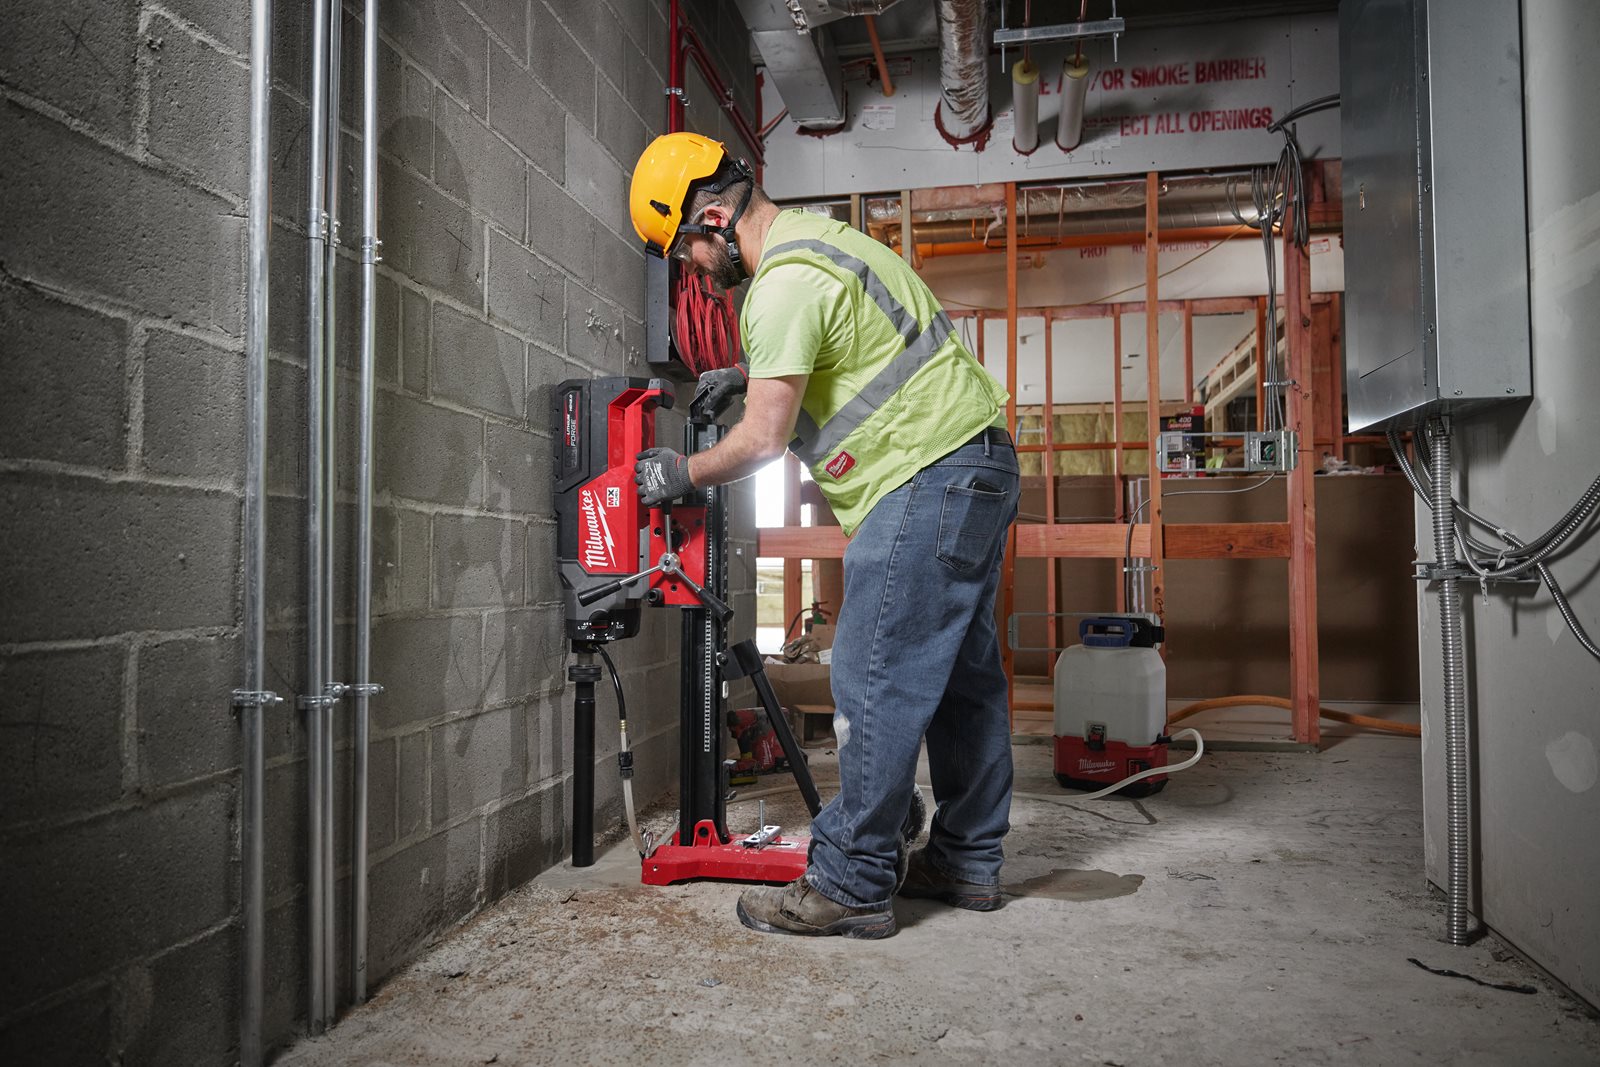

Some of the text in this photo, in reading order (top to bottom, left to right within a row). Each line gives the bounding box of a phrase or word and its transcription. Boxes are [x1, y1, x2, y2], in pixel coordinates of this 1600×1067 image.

[1130, 62, 1190, 89] SMOKE
[1195, 56, 1267, 84] BARRIER
[1154, 111, 1185, 135] ALL
[1188, 107, 1273, 132] OPENINGS
[607, 489, 615, 506] MX
[582, 489, 609, 568] Milwaukee
[1079, 758, 1116, 771] Milwaukee
